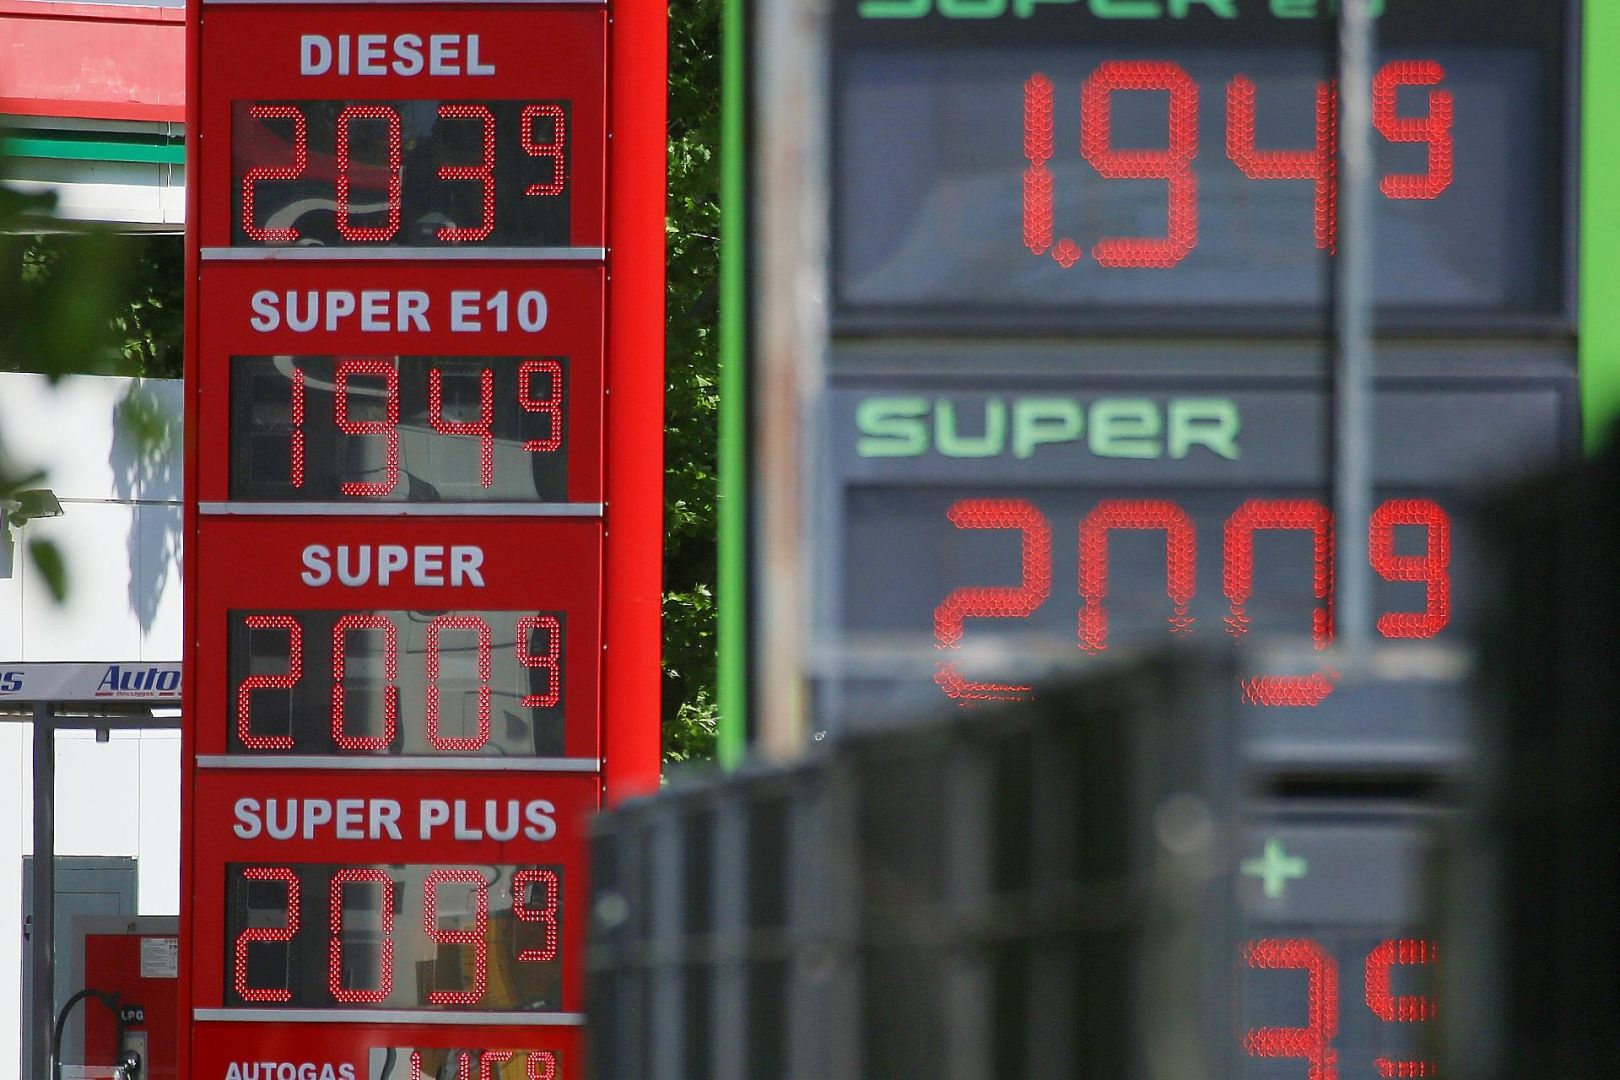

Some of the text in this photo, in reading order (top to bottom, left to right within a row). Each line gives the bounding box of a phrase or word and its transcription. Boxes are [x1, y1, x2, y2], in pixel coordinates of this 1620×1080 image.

[300, 33, 497, 76] DIESEL
[250, 290, 549, 333] SUPER E10
[855, 397, 1241, 460] SUPER
[300, 544, 485, 588] SUPER
[97, 665, 182, 692] Auto
[233, 798, 557, 841] SUPER PLUS
[121, 1010, 144, 1021] LPG
[225, 1062, 356, 1080] AUTOGAS
